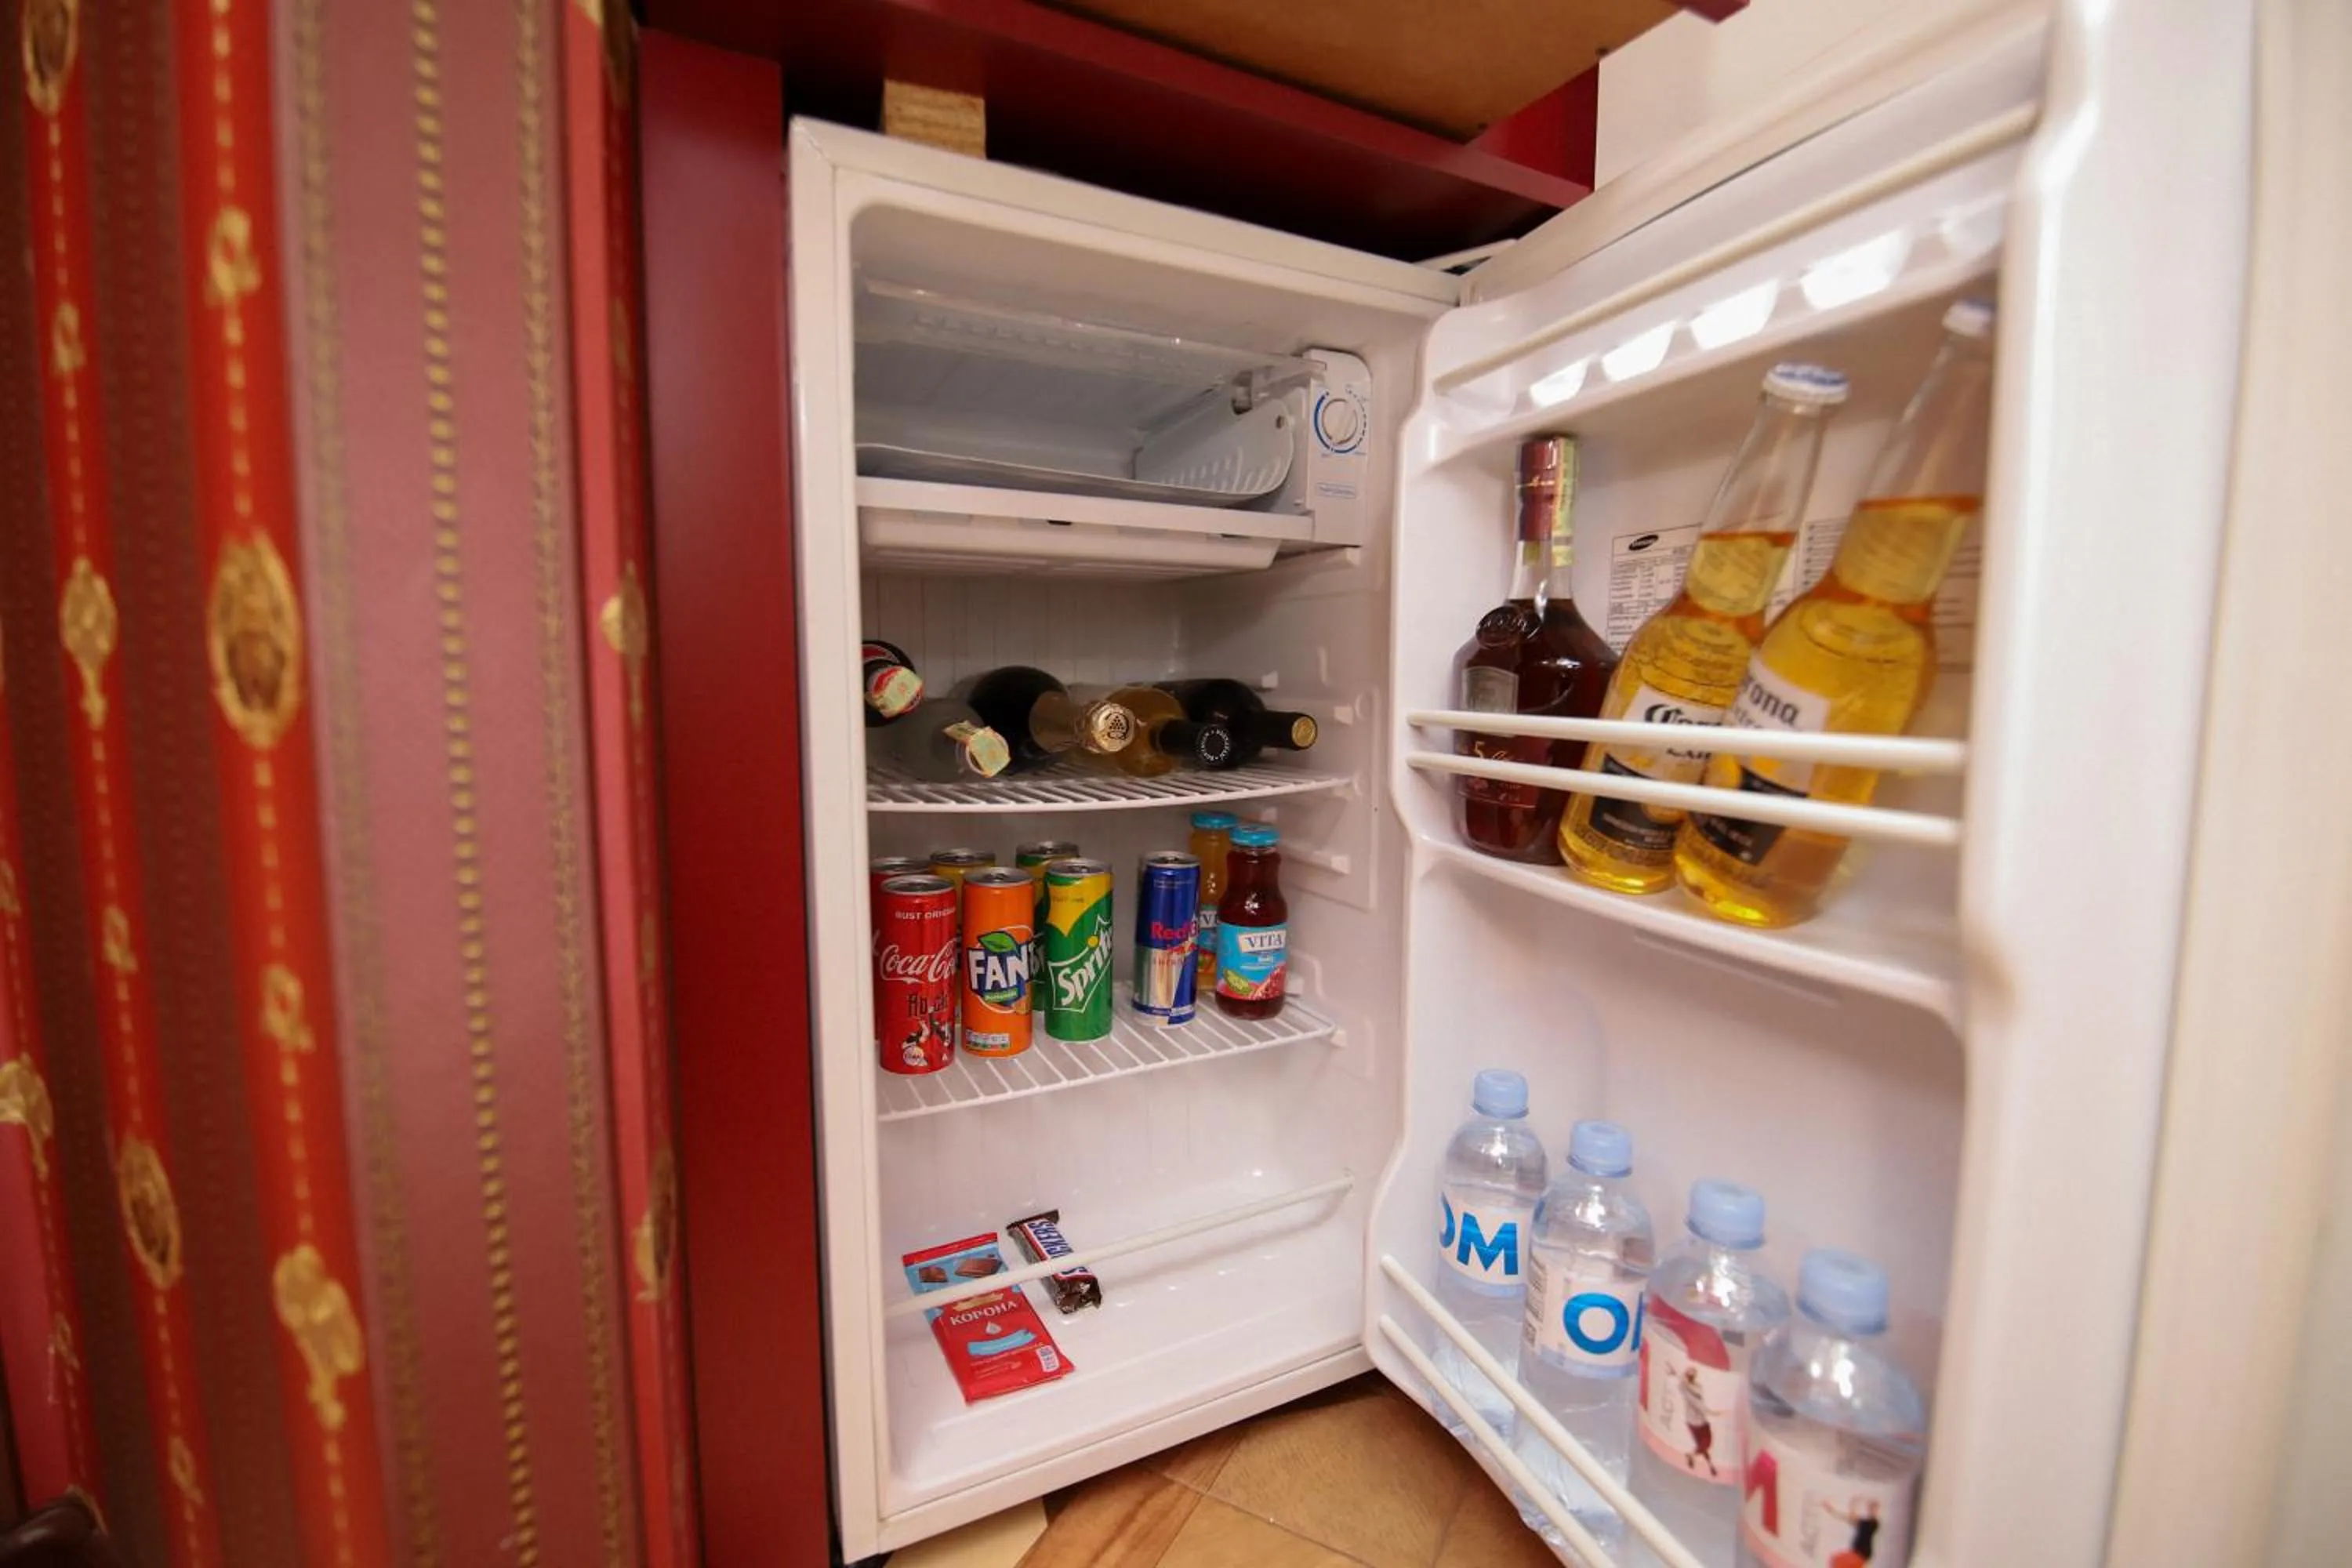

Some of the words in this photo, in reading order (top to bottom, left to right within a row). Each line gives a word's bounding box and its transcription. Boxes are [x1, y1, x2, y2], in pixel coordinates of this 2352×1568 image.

[880, 937, 956, 987] Coca-Co
[1244, 933, 1283, 948] VITA
[968, 943, 1029, 990] FAN
[1563, 1292, 1643, 1356] O
